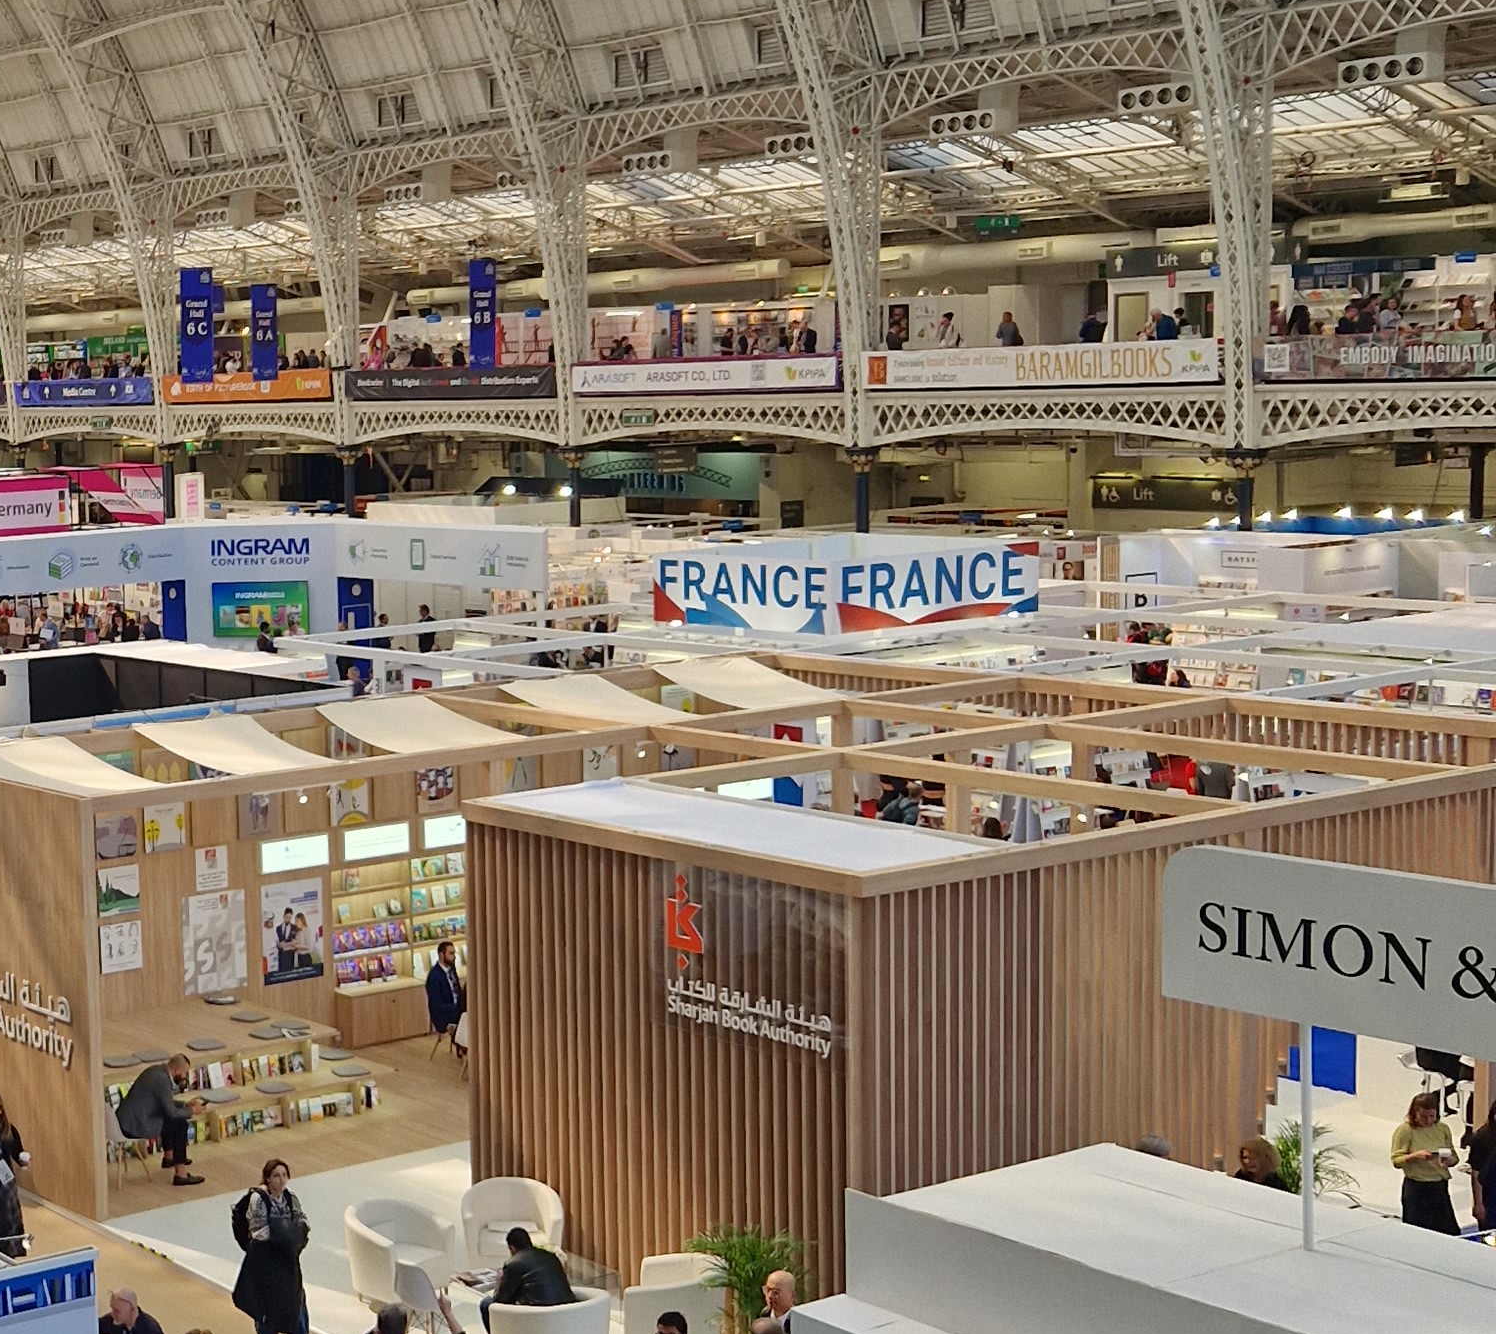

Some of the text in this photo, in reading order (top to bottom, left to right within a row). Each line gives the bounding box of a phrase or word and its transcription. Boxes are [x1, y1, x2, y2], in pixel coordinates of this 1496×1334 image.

[1157, 253, 1179, 267] Lift
[185, 299, 208, 308] Grand
[474, 311, 491, 324] 6 B
[187, 322, 208, 336] 6 C
[256, 329, 273, 341] 6 A
[1015, 347, 1172, 381] BARAMGILBOOKS
[1340, 345, 1399, 365] EMBODY
[591, 372, 636, 384] ARASOFT
[646, 371, 689, 382] ARASOFT
[713, 369, 732, 381] LTD.
[798, 368, 826, 379] KPIPA
[1133, 487, 1155, 501] Lift
[211, 538, 311, 556] INGRAM
[211, 556, 311, 567] CONTENT GROUP
[659, 559, 827, 610] FRANCE
[841, 550, 1025, 610] FRANCE
[1199, 902, 1496, 1005] SIMON &
[19, 979, 71, 1023] هيئة
[667, 976, 831, 1032] هيئة الشارقة للكتاب
[668, 995, 831, 1059] Sharjah Book Authority
